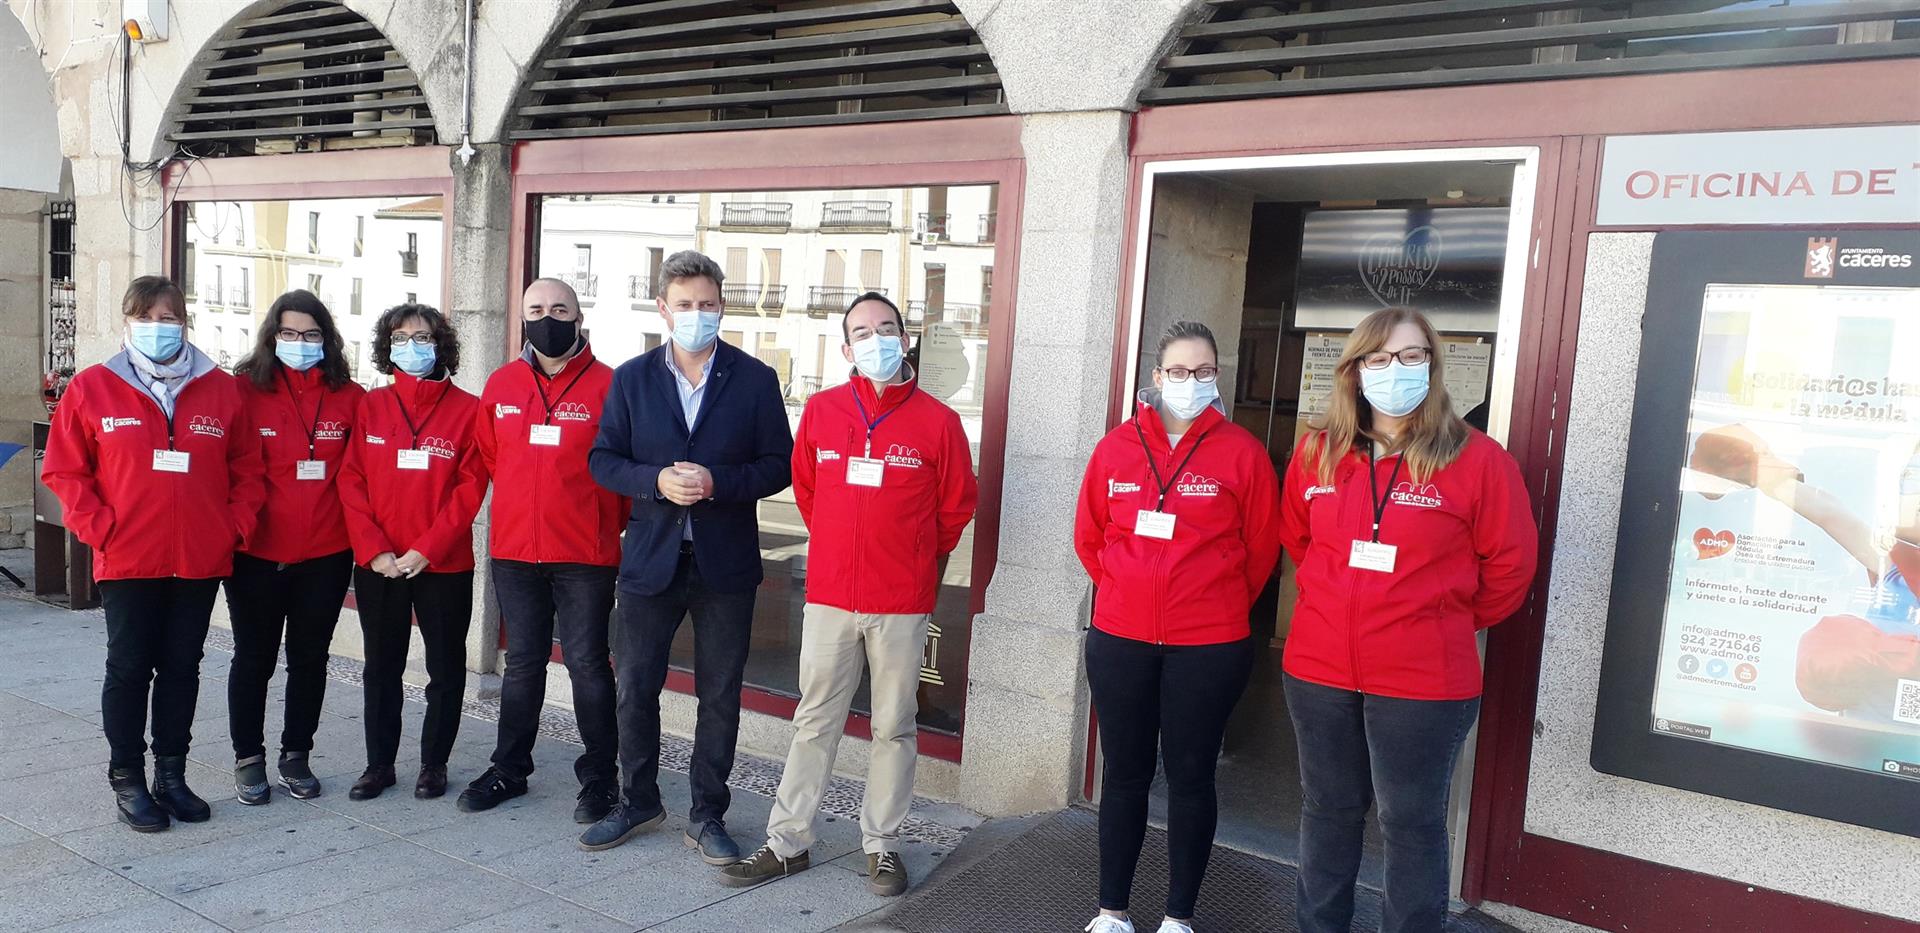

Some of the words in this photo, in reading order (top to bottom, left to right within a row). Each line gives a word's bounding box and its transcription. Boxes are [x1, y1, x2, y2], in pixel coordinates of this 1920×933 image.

[1831, 169, 1897, 196] DE
[1700, 539, 1728, 548] ADMO
[1685, 578, 1743, 593] Infórmate,
[1745, 585, 1777, 598] hazte
[1779, 590, 1828, 604] donante
[1696, 591, 1726, 603] únete
[1752, 599, 1818, 615] solidaridad
[1682, 623, 1762, 643] info@admo.es
[1681, 634, 1705, 646] 924
[1709, 637, 1760, 653] 271646
[1680, 645, 1760, 663] www.admo.es
